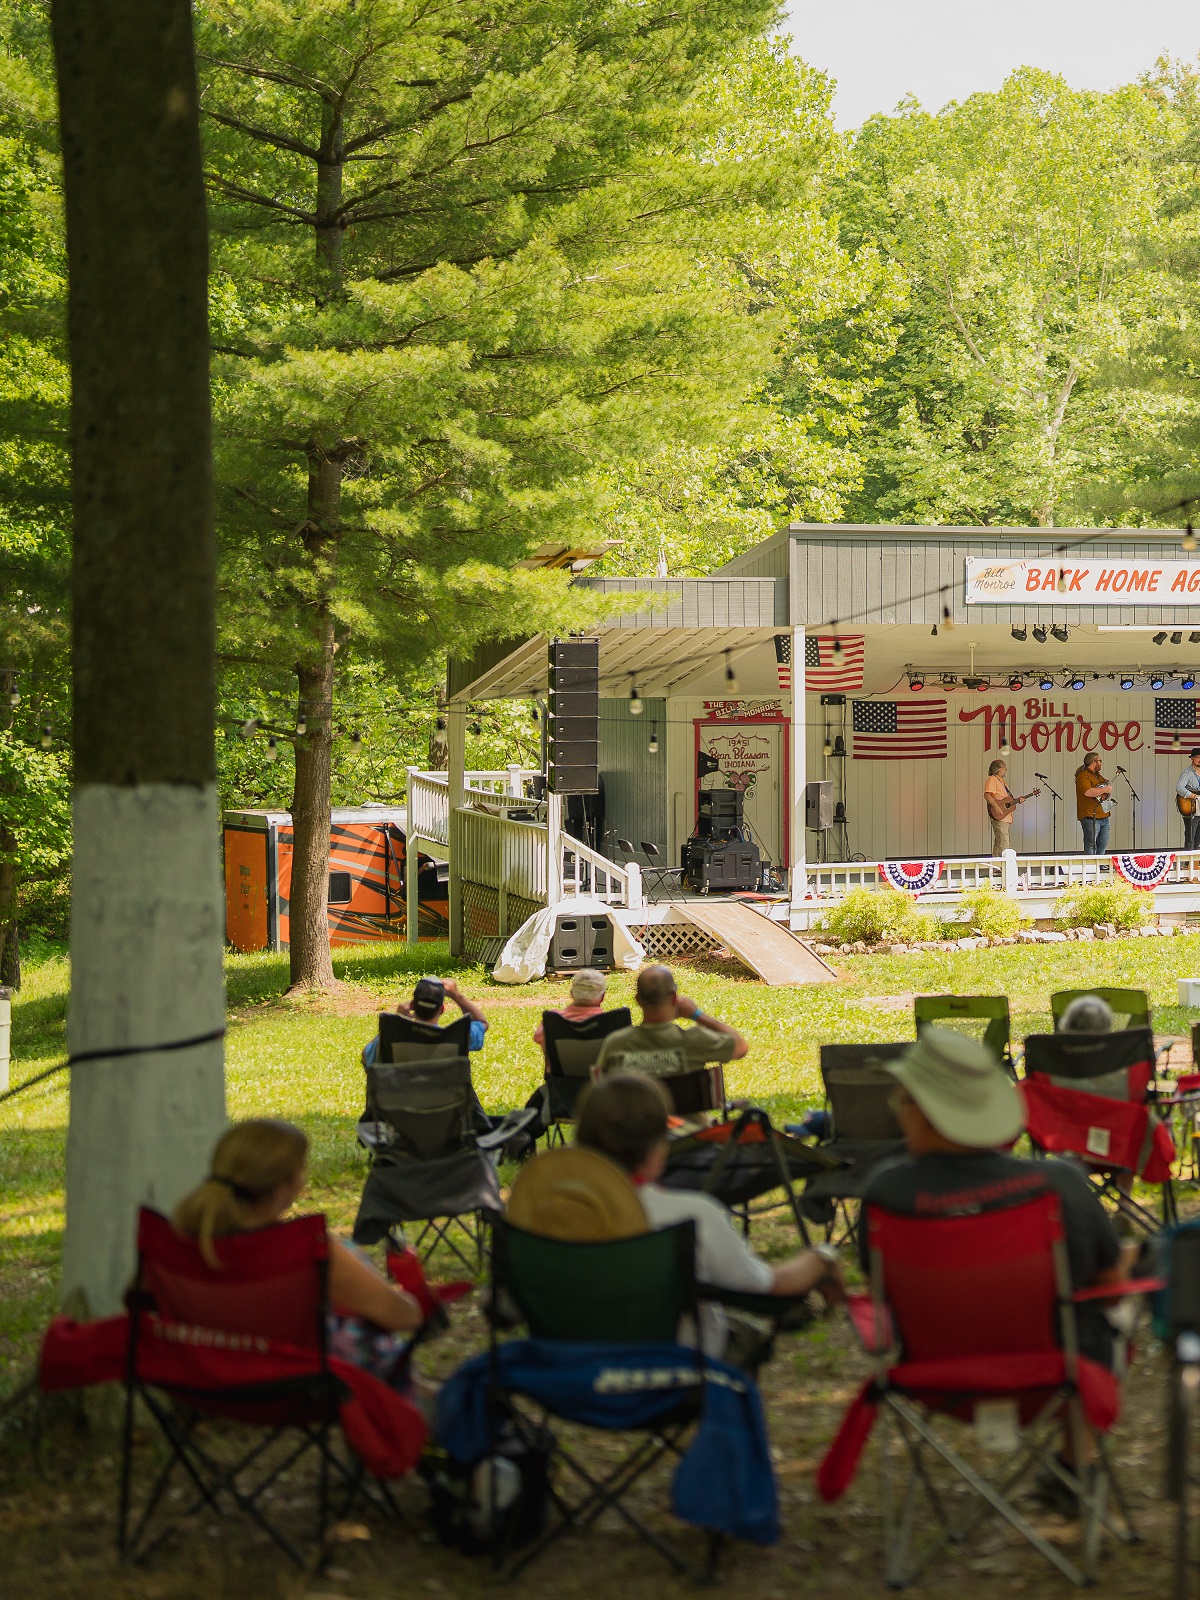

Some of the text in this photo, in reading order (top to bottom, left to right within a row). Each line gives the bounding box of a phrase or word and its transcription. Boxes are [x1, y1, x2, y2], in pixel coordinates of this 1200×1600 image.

[983, 567, 1005, 578] Bill
[974, 578, 1016, 591] Monroe
[1095, 569, 1162, 592] HOME
[744, 702, 775, 717] MONROE
[709, 747, 769, 760] Bean Blossom
[724, 761, 756, 769] INDIANA
